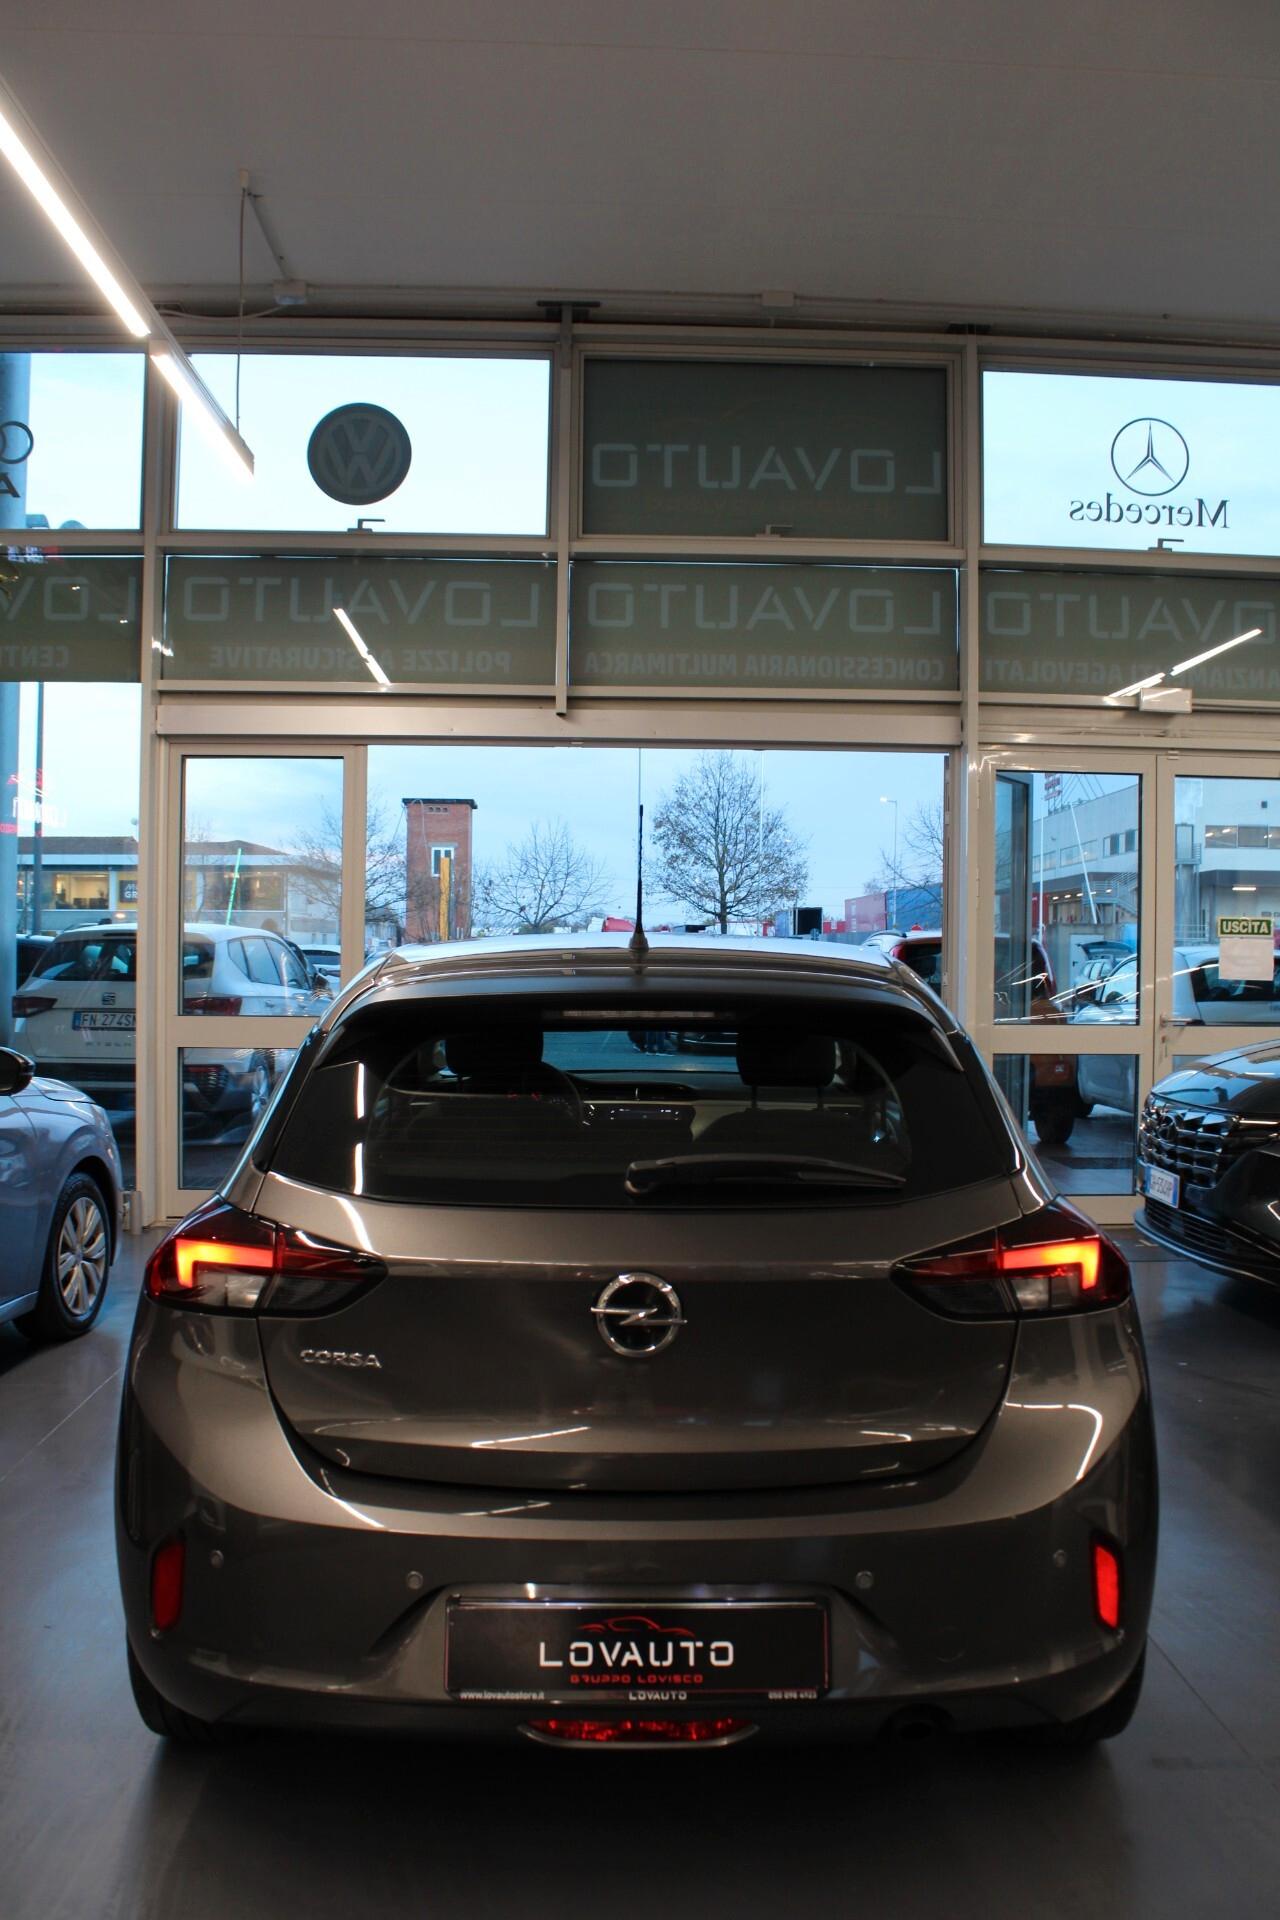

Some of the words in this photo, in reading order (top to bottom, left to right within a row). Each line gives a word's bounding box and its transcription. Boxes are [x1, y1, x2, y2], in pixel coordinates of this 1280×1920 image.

[1222, 920, 1269, 934] USCITA
[299, 1349, 383, 1369] CORSA
[538, 1641, 734, 1667] LOVAUTO
[569, 1673, 632, 1684] GRUPPO
[637, 1673, 704, 1684] LOVISCO
[628, 1690, 687, 1701] LOVAUTO
